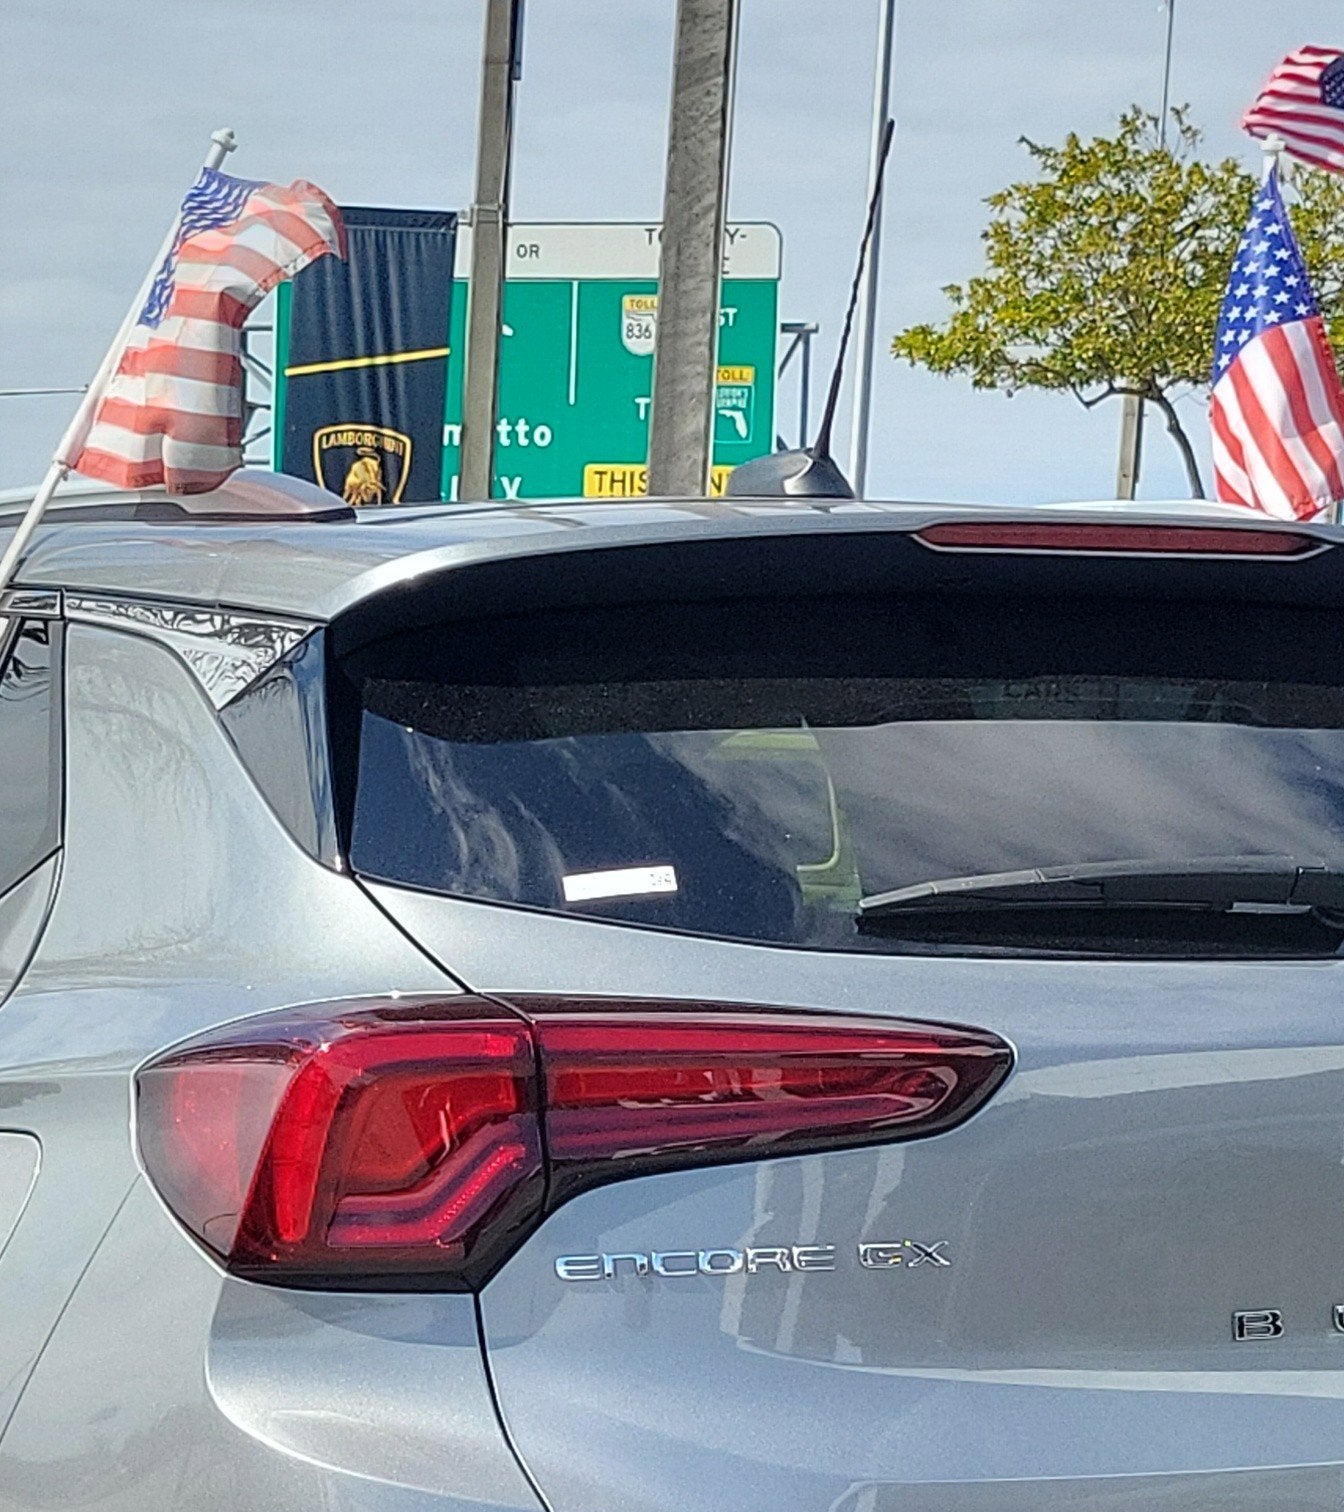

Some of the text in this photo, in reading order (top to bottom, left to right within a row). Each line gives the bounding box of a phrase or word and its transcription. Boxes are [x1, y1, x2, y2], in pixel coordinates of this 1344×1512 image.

[516, 243, 540, 259] OR
[629, 299, 657, 309] TOLL
[626, 322, 652, 339] 836
[594, 470, 648, 493] THIS
[556, 1240, 952, 1281] ENCORE GX
